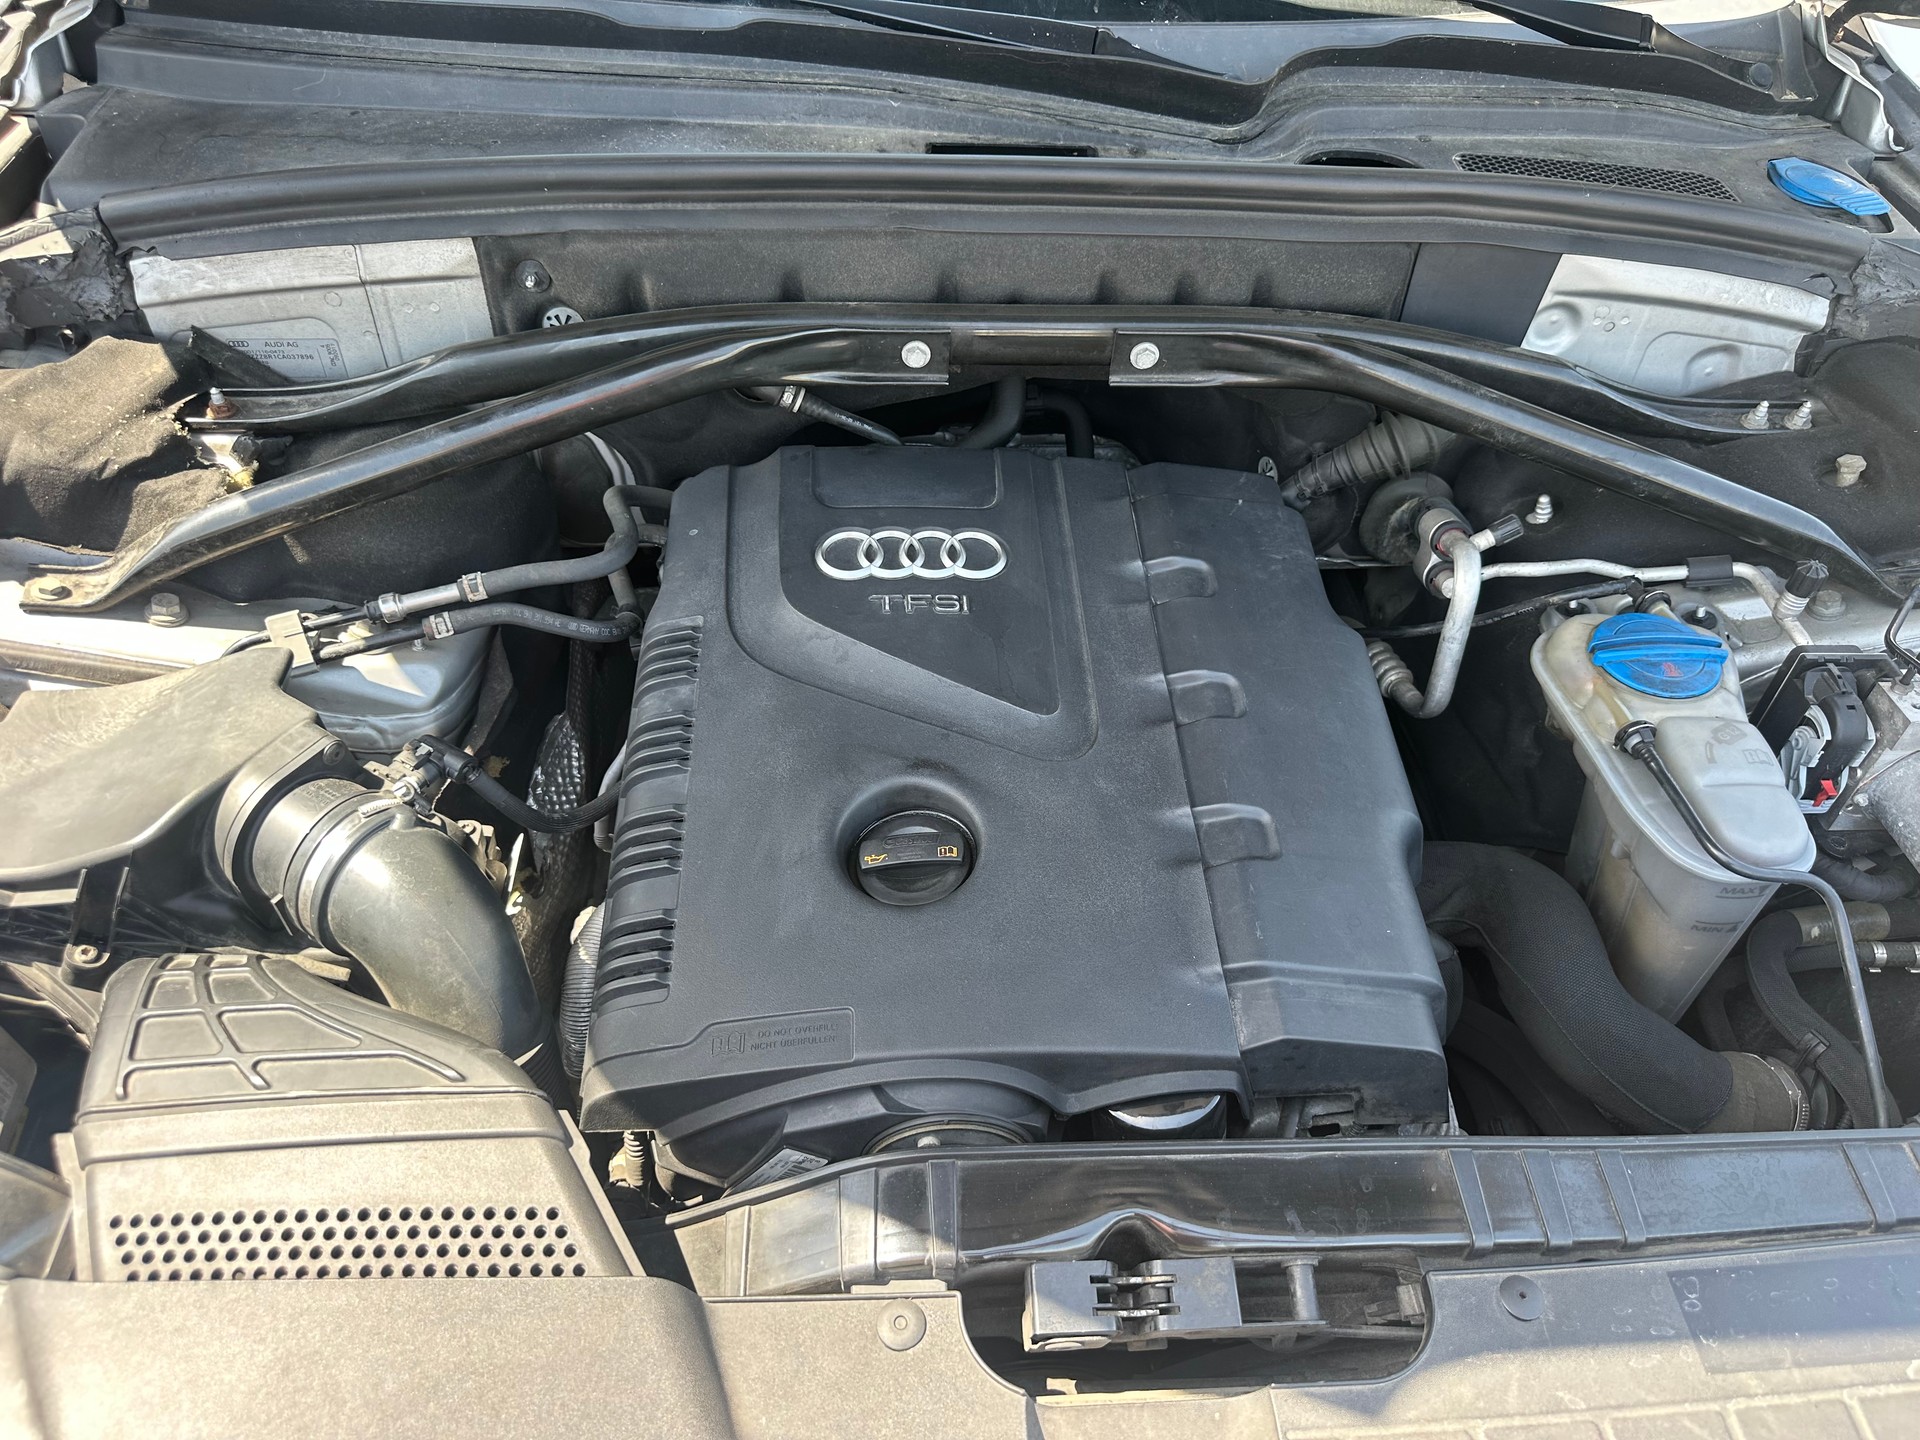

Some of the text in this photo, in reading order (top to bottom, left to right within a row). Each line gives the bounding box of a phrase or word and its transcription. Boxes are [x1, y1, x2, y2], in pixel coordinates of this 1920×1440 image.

[868, 594, 970, 615] TFSI
[1719, 886, 1757, 895] MAX
[1690, 924, 1724, 934] MIN
[750, 1041, 778, 1051] NICHT
